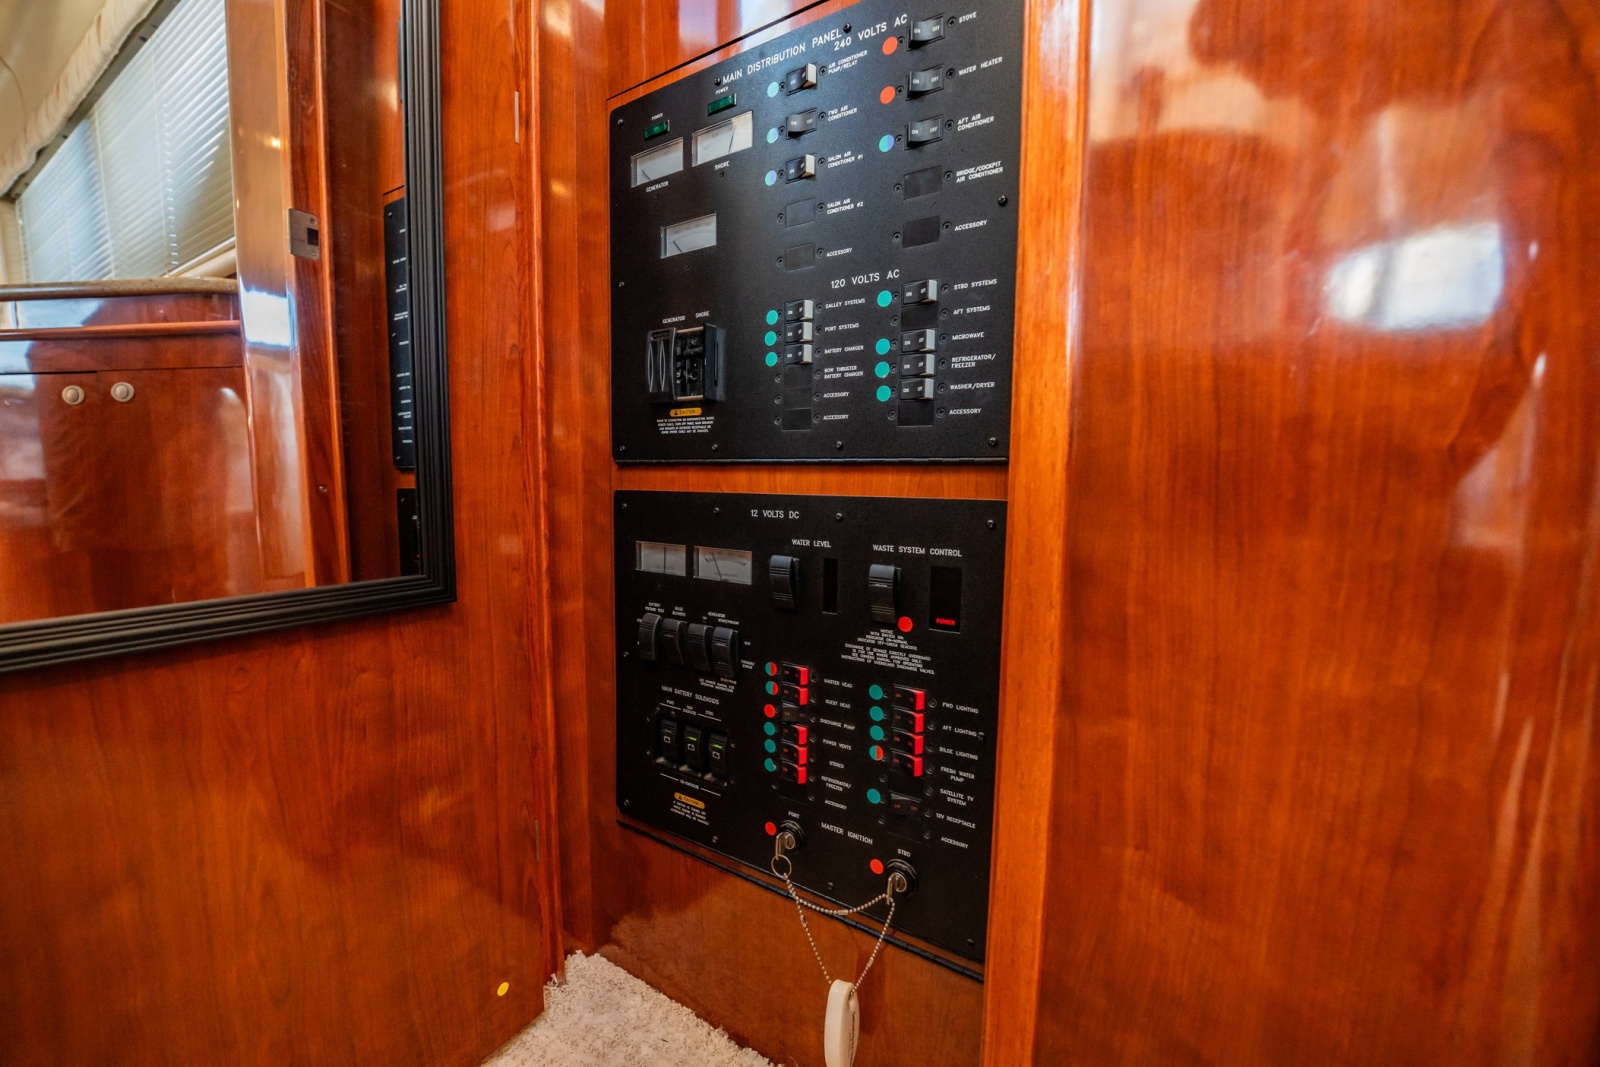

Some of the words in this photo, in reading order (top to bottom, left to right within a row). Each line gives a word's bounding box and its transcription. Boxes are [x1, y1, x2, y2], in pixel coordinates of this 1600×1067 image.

[959, 12, 977, 23] STOVE
[834, 37, 851, 51] 240
[858, 22, 887, 40] VOLTS
[894, 14, 907, 27] AC
[723, 69, 742, 84] MAIN
[748, 43, 805, 74] DISTRIBUTION
[812, 28, 842, 48] PANEL
[838, 50, 867, 65] CONDITIONER
[828, 60, 857, 74] PUMP/RELAY
[959, 65, 976, 75] WATER
[981, 57, 1002, 68] HEATER
[828, 108, 857, 121] CONDITIONER
[958, 117, 968, 125] AFT
[958, 116, 994, 131] CONDITIONER
[715, 161, 729, 170] SHORE
[828, 157, 854, 168] CONDITIONER
[956, 161, 1001, 176] BRIDGE/COCKPIT
[969, 167, 1003, 179] CONDITIONER
[646, 181, 668, 192] GENERATOR
[827, 204, 854, 214] CONDITIONER
[955, 220, 987, 231] ACCESSORY
[826, 248, 852, 257] ACCESSORY
[831, 279, 845, 288] 120
[852, 273, 880, 285] VOLTS
[887, 269, 899, 279] AC
[971, 279, 997, 287] SYSTEMS
[952, 332, 984, 340] MICROWAVE
[952, 354, 996, 362] REFRIGERATOR/
[873, 544, 894, 552] WASTE
[930, 548, 962, 557] CONTROL
[674, 688, 692, 698] BATTERY
[695, 694, 719, 704] SOLENOIDS
[956, 705, 978, 713] LIGHTING
[820, 718, 841, 727] DISCHARGE
[955, 727, 976, 736] LIGHTING
[956, 751, 978, 760] LIGHTING
[959, 771, 974, 779] WATER
[826, 783, 842, 791] FREEZER
[940, 789, 964, 799] SATELLITE
[825, 800, 847, 810] ACCESSORY
[947, 797, 966, 806] SYSTEM
[947, 816, 976, 829] RECEPTACLE
[821, 822, 843, 834] MASTER
[848, 831, 873, 845] IGNITION
[941, 837, 968, 849] ACCESSORY
[898, 849, 910, 857] STBD
